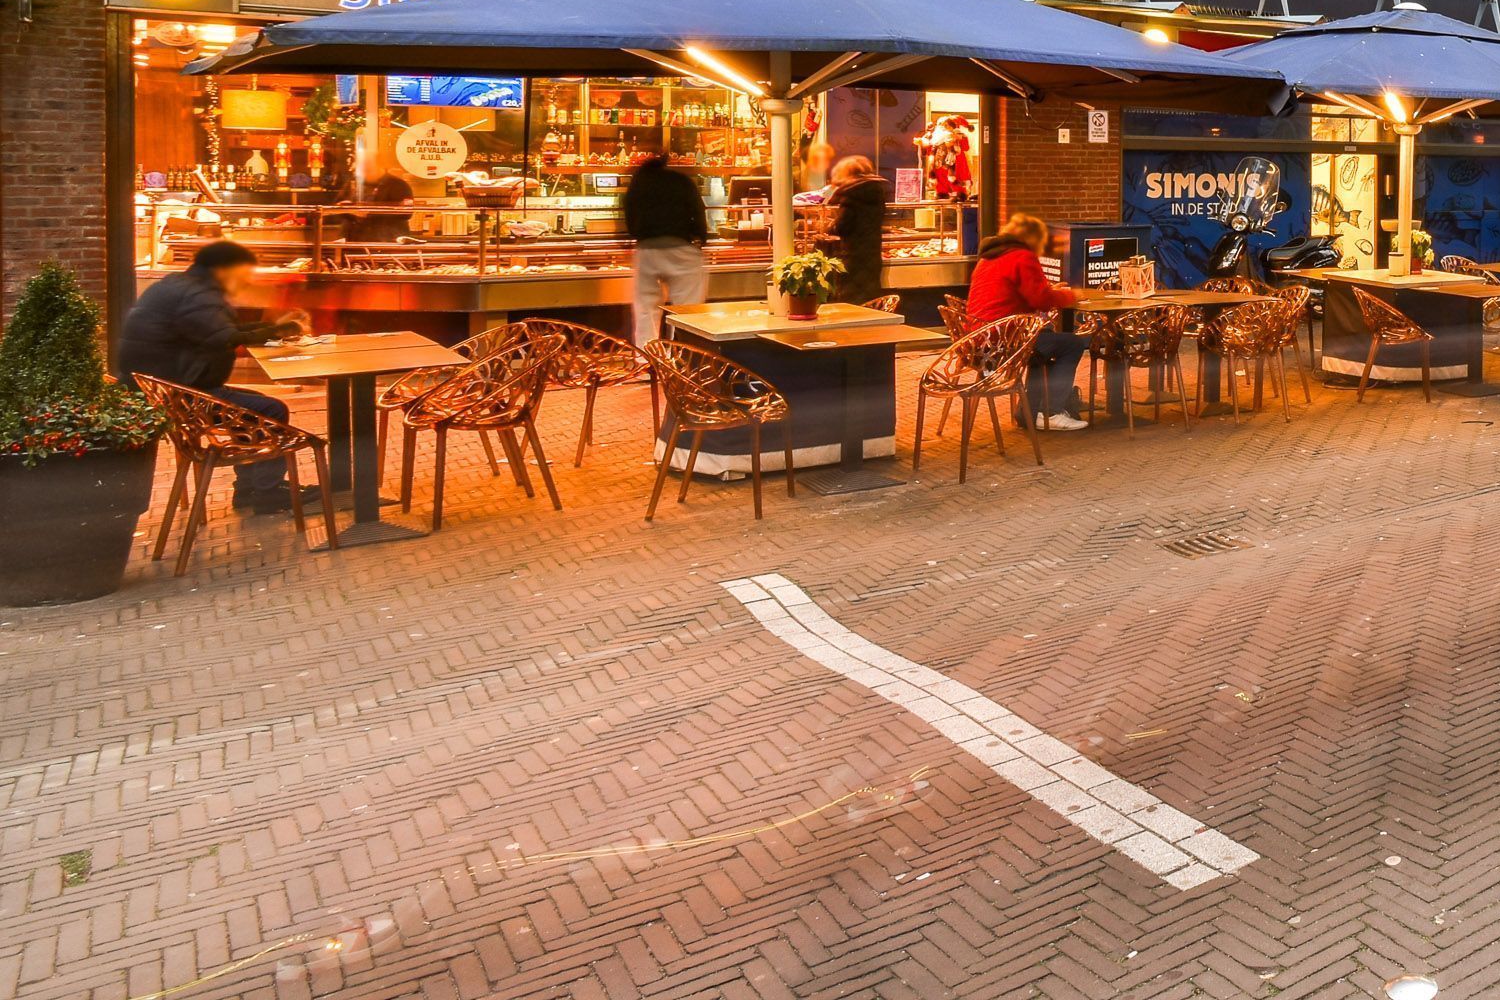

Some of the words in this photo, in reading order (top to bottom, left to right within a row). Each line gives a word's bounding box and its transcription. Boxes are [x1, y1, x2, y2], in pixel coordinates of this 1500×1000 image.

[1146, 172, 1261, 199] SIMONIS
[1171, 203, 1182, 215] IN
[1187, 203, 1203, 215] DE
[1207, 202, 1238, 215] STAD
[1088, 261, 1121, 271] HOLLAN
[1087, 271, 1110, 279] NIEUWS
